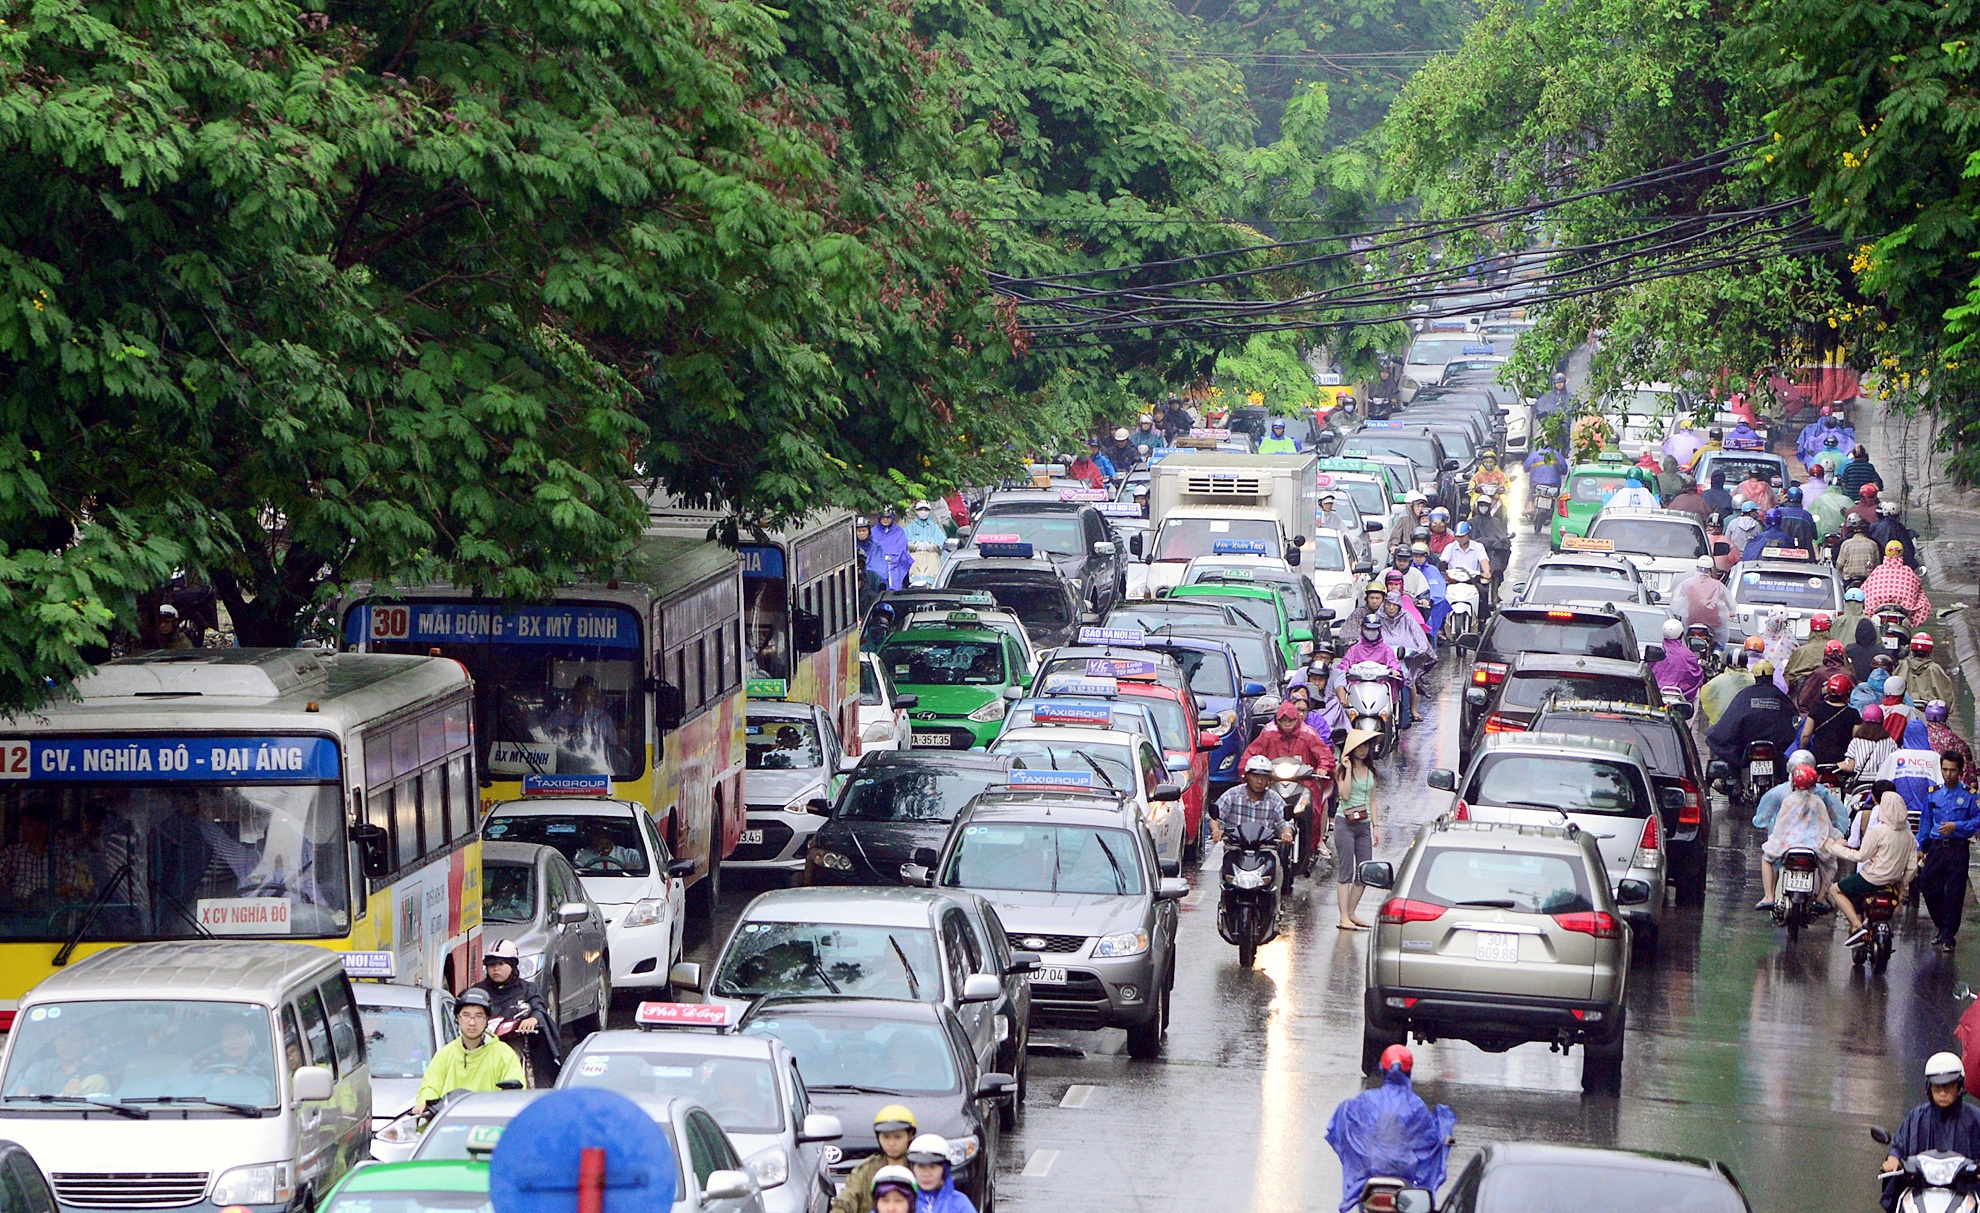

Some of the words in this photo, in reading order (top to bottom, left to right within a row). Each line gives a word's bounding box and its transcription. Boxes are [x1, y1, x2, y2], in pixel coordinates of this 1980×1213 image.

[374, 608, 407, 637] 30
[418, 613, 450, 635] MAI
[455, 610, 503, 639] ĐỘNG
[518, 615, 541, 637] BX
[546, 612, 572, 638] MỸ
[576, 615, 618, 639] ĐÌNH
[1084, 629, 1101, 638] SAO
[1045, 708, 1108, 718] TAXIGROUP
[41, 748, 76, 772] CV.
[83, 744, 153, 772] NGHĨA
[158, 744, 189, 772] ĐÔ
[211, 747, 249, 776] ĐẠI
[255, 742, 303, 772] ÁNG
[495, 750, 509, 762] BX
[536, 779, 606, 788] TAXIGROUP
[1020, 775, 1089, 785] TAXIGROUP
[739, 831, 761, 843] 3.45
[202, 907, 210, 924] X
[212, 906, 229, 924] CV
[231, 903, 268, 924] NGHĨA
[271, 902, 288, 923] ĐÔ
[1487, 933, 1509, 947] 30A
[1477, 946, 1517, 961] 609.86
